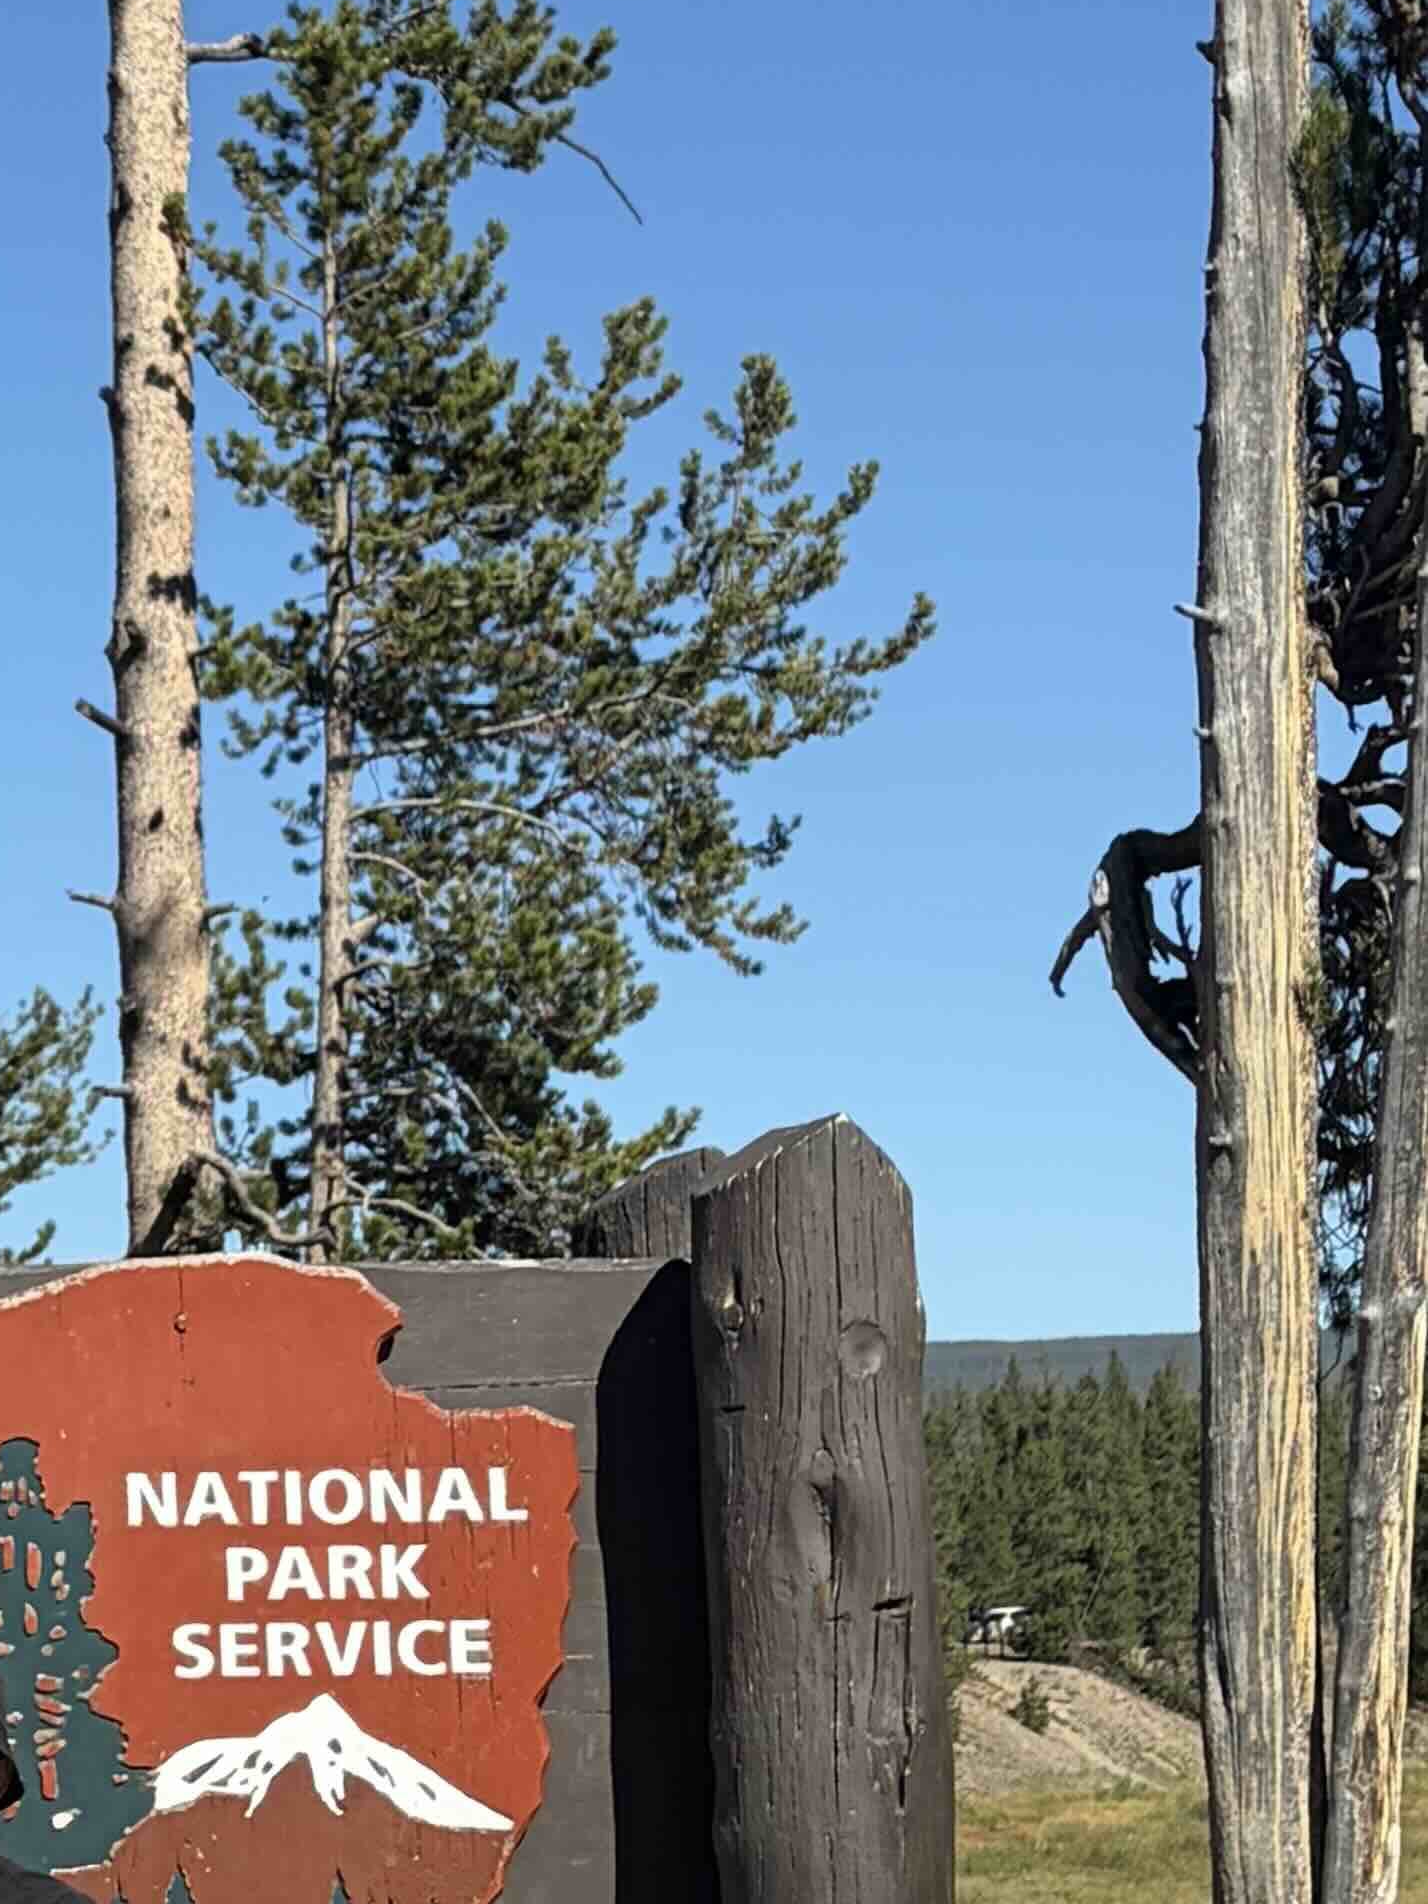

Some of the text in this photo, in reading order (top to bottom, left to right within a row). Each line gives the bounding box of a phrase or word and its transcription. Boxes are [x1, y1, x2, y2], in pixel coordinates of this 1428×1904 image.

[124, 1466, 530, 1528] NATIONAL
[224, 1544, 431, 1602] PARK
[171, 1618, 493, 1680] SERVICE
